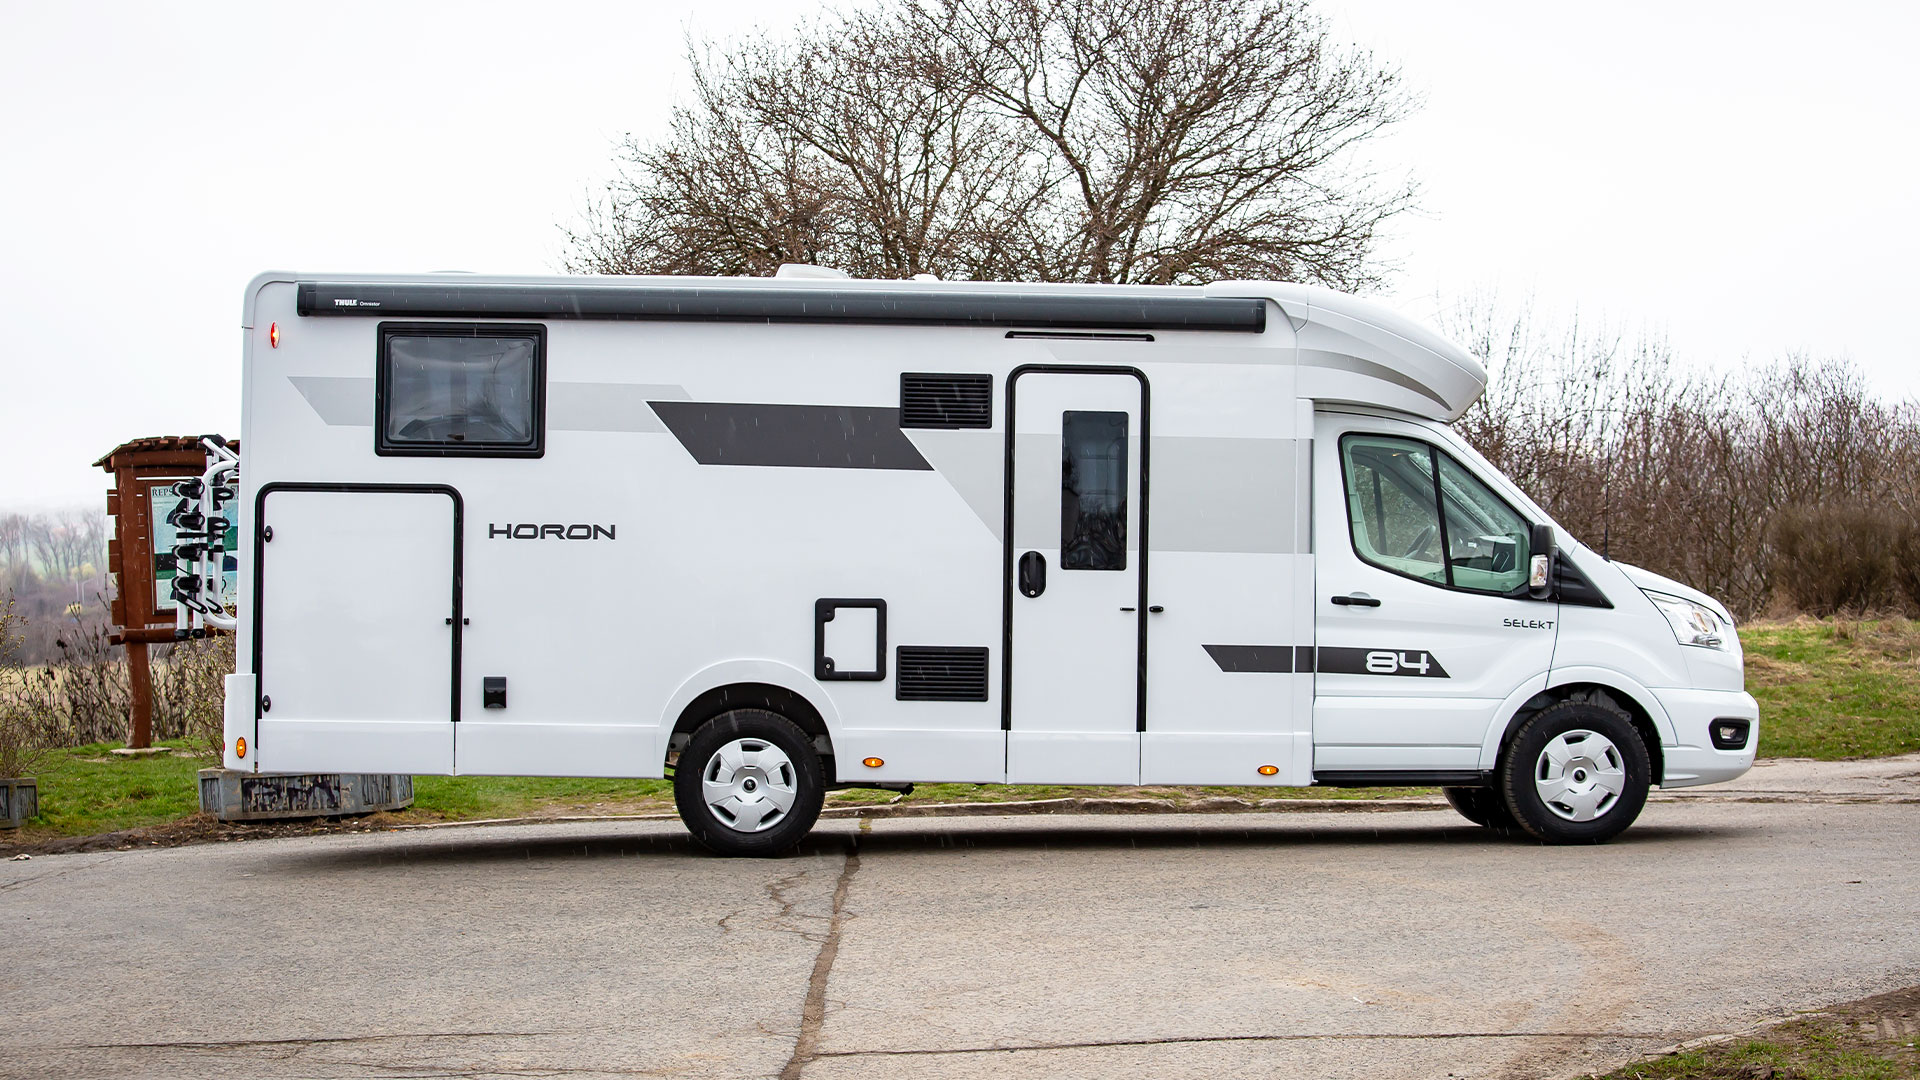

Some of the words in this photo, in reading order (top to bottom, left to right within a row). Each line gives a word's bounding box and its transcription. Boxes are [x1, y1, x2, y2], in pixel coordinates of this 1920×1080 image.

[489, 523, 616, 540] HORON
[1503, 618, 1554, 630] SELEKT
[1366, 651, 1430, 675] 84
